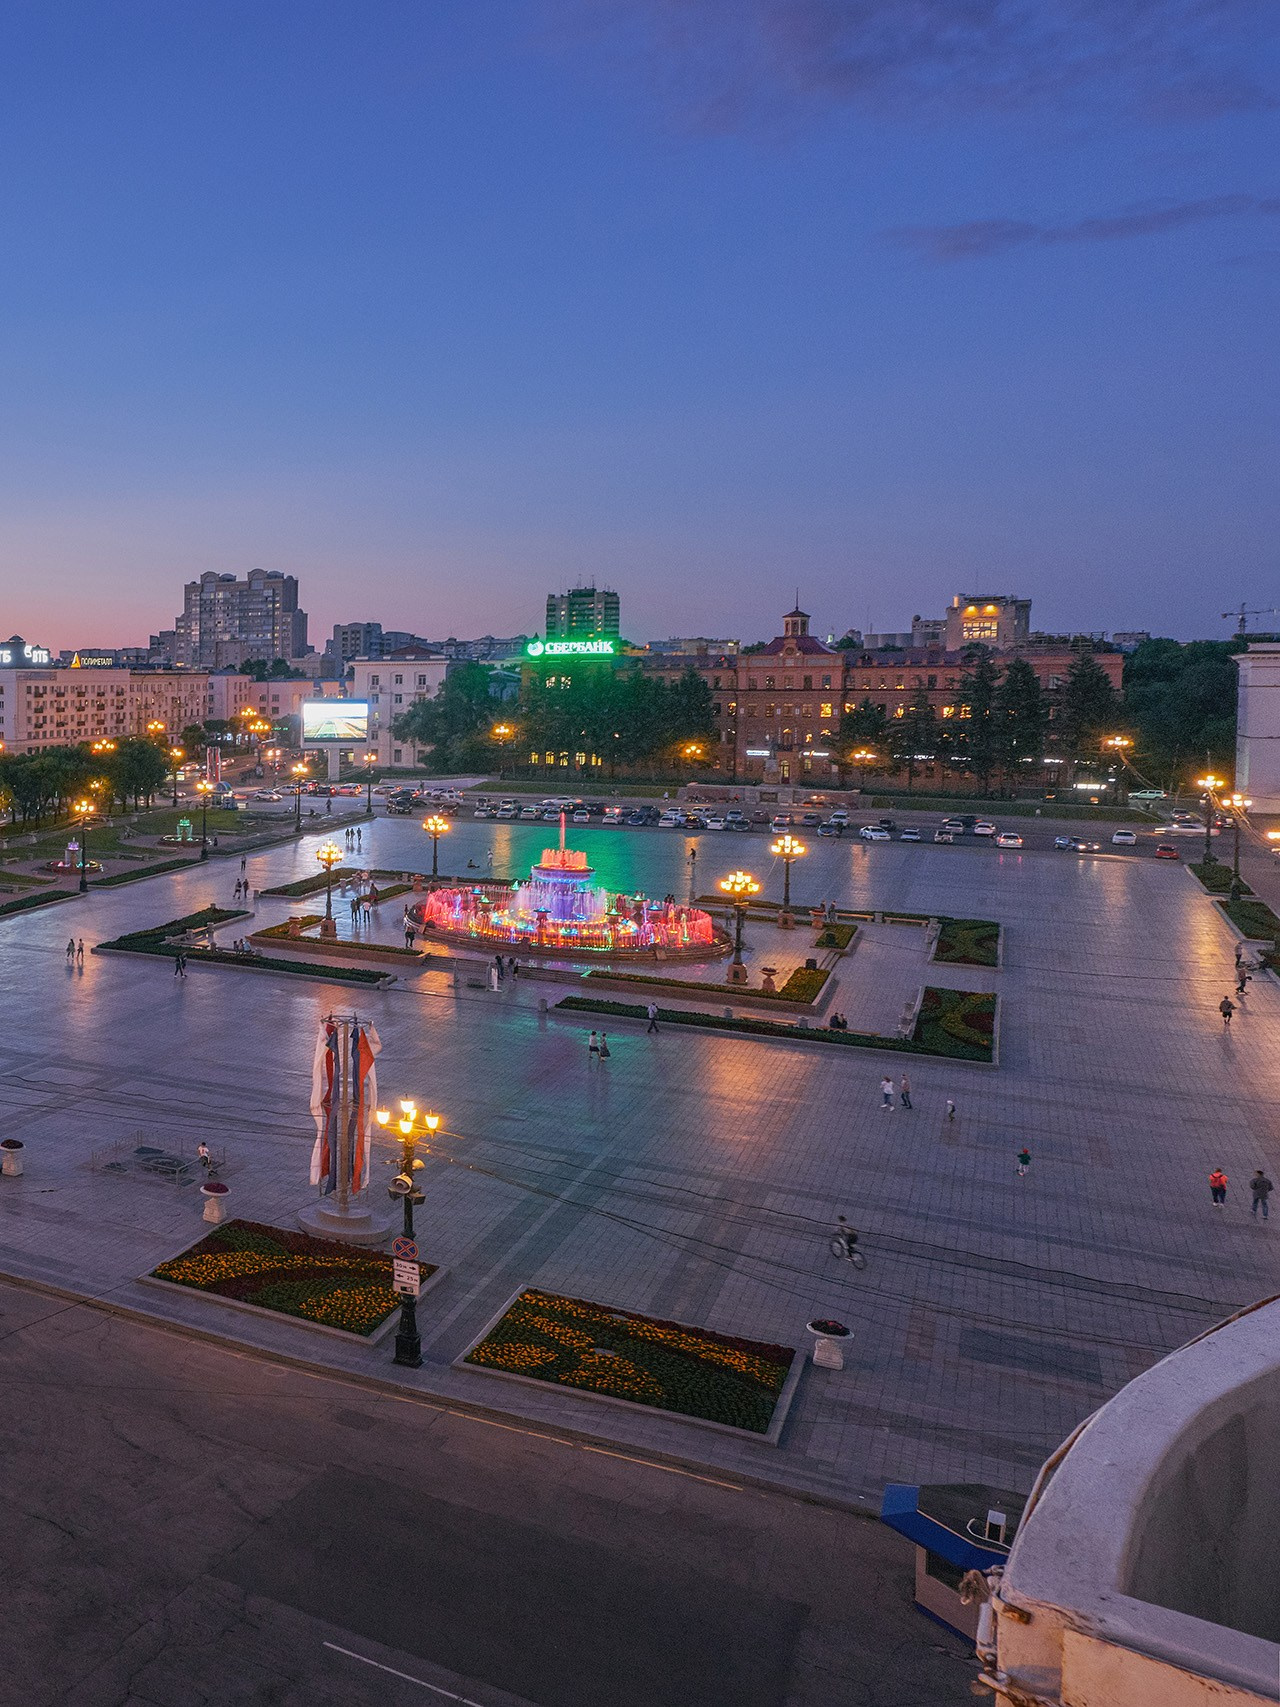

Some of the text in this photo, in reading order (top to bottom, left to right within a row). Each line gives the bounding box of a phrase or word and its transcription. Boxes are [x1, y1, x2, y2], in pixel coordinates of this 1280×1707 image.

[545, 641, 614, 654] СБЕРБАНК
[32, 650, 48, 663] ВТБ
[81, 657, 113, 666] ПОЛИМЕТАЛЛ
